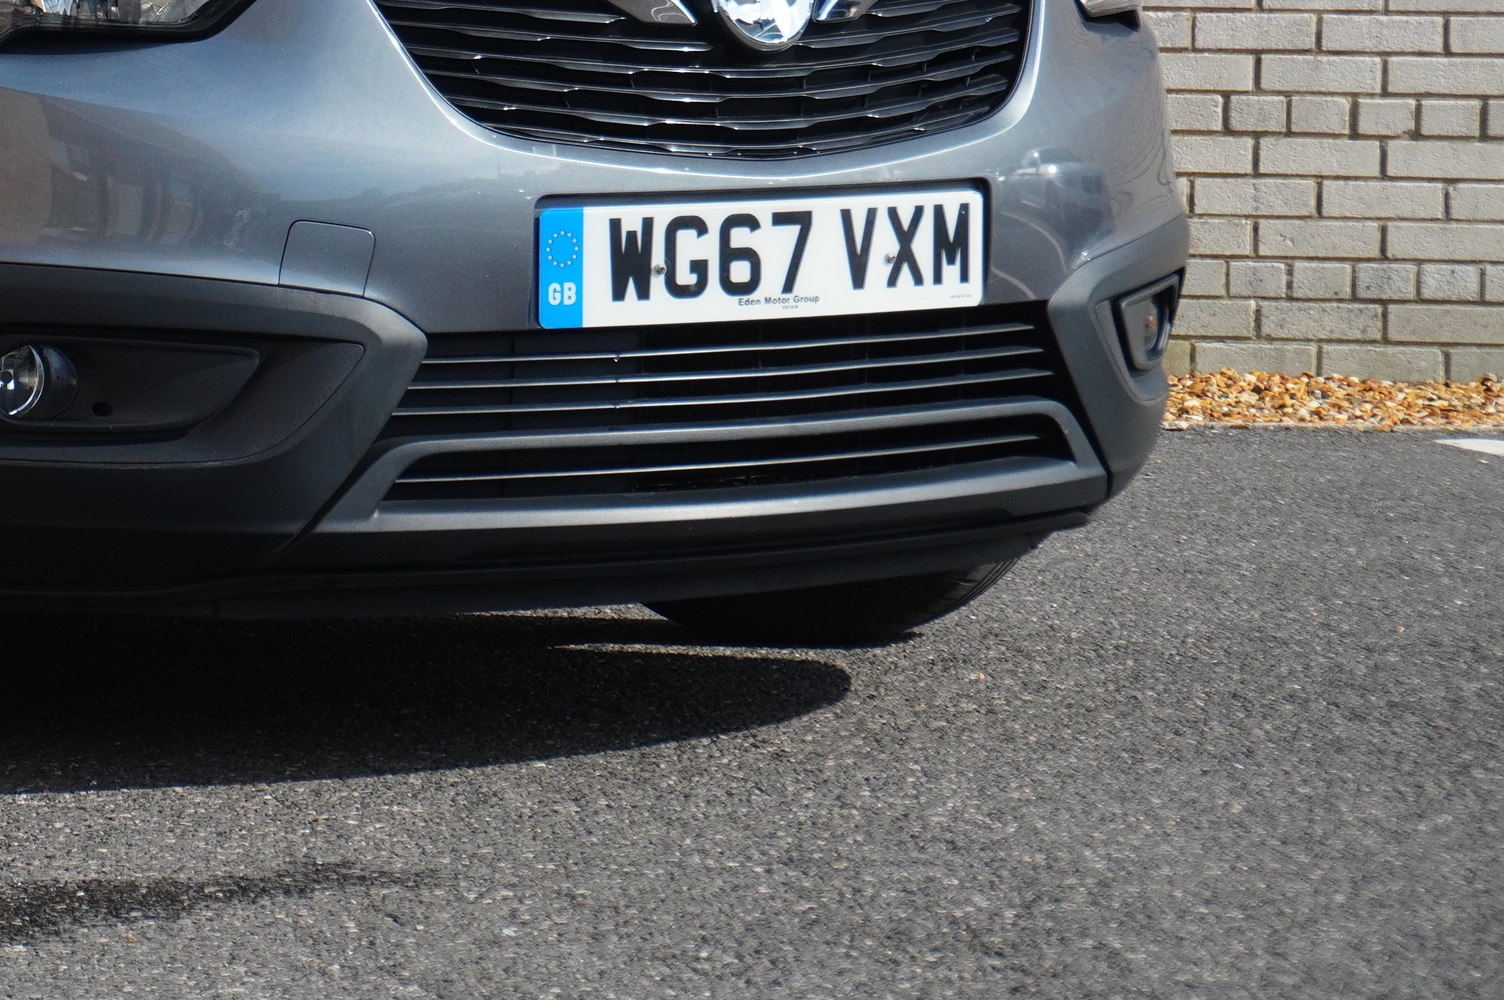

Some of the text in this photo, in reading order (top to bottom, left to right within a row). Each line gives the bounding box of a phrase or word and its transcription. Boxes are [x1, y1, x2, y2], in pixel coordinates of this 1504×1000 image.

[607, 202, 970, 302] WG67 VXM
[547, 281, 577, 306] GB
[738, 295, 820, 306] Eden Motor Group
